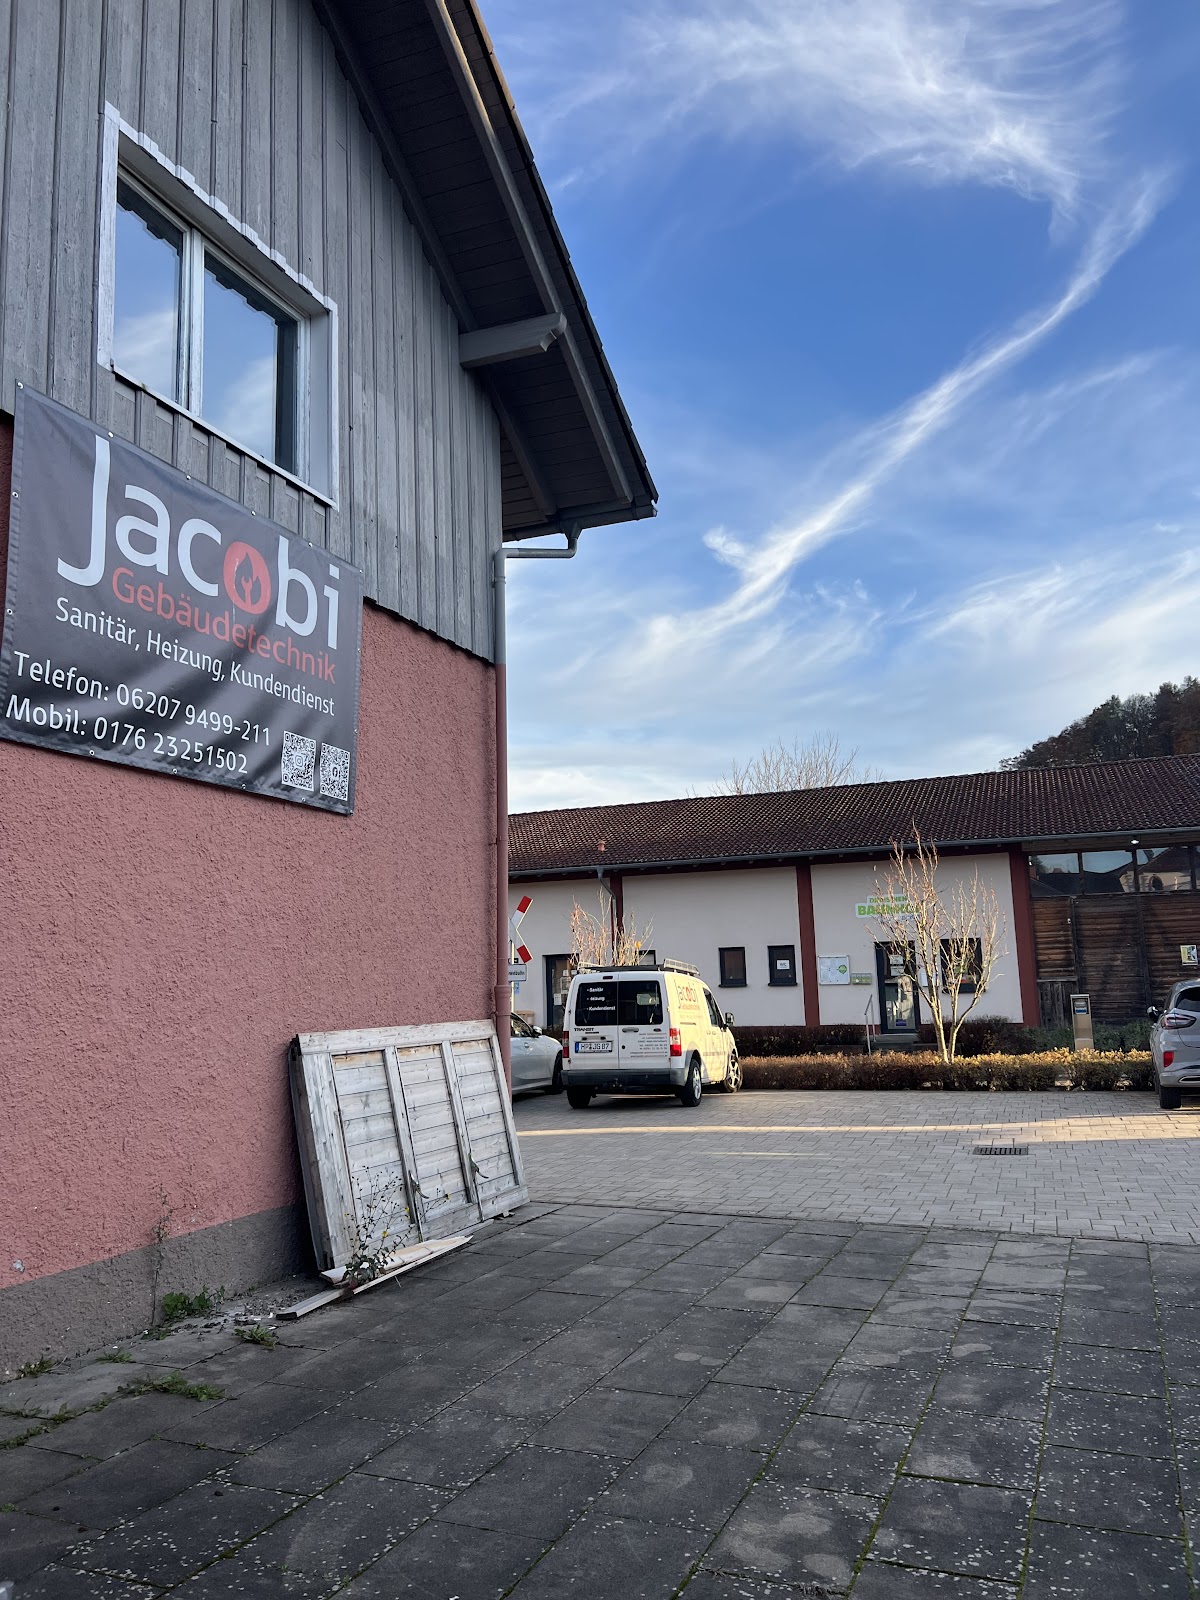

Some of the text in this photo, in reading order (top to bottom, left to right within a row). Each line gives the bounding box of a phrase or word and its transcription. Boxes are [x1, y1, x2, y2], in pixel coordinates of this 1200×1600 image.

[57, 435, 340, 650] Jacobi
[55, 597, 335, 717] Sanitär, Heizung, Kundendienst
[112, 567, 336, 684] Gebäudetechnik
[5, 694, 248, 774] Mobil: 0176 23251502
[14, 650, 270, 746] Telefon: 06207 9499-211
